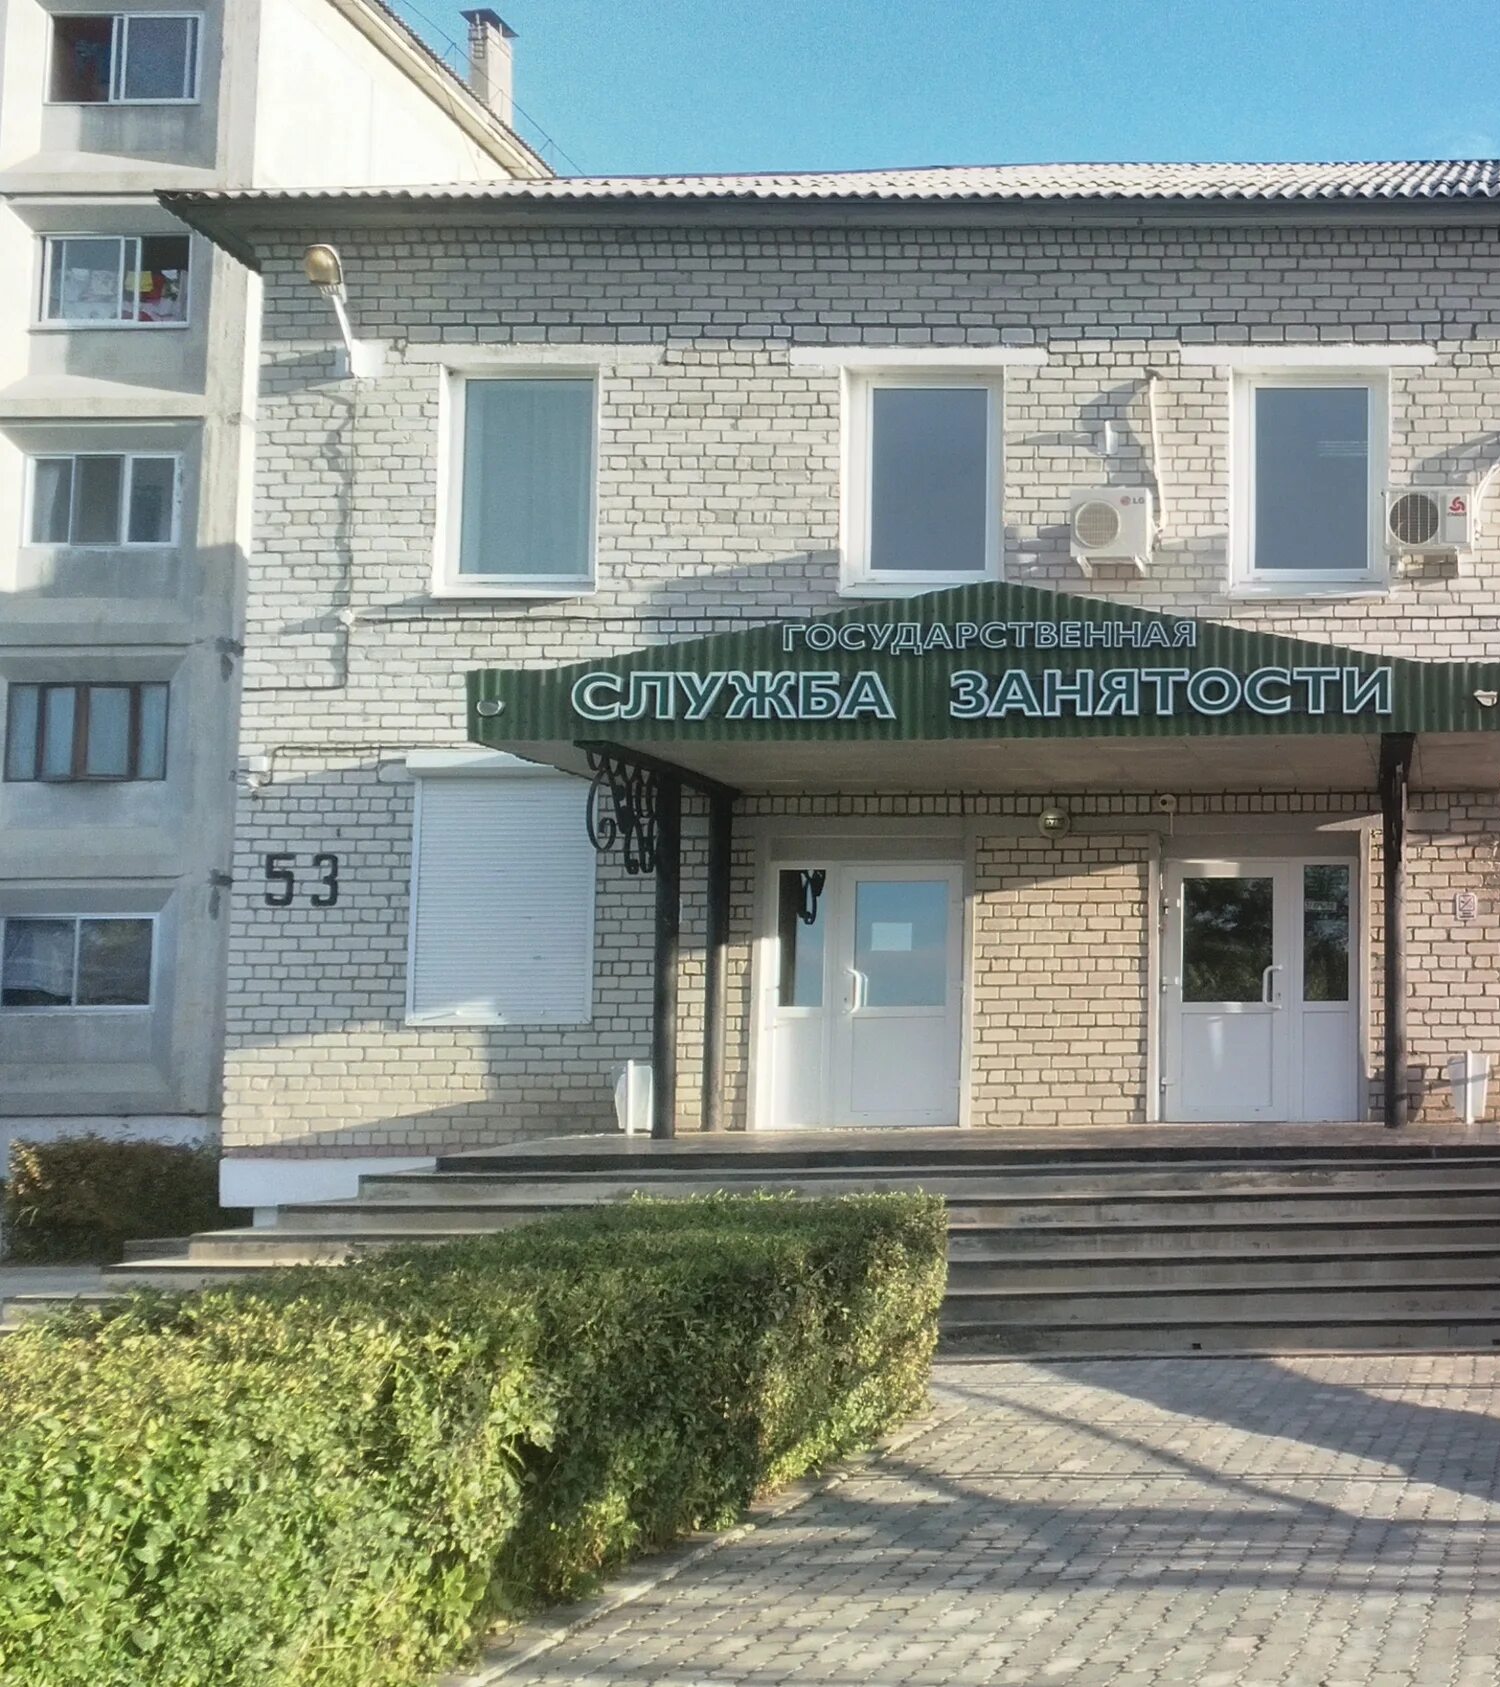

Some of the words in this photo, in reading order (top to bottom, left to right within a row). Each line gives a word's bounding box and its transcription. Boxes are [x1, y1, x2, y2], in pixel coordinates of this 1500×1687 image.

[1132, 496, 1145, 504] LG
[782, 621, 1197, 655] ГОСУДАРСТВЕННАЯ
[571, 671, 896, 720] СЛУЖБА
[950, 667, 1392, 717] ЗАНЯТОСТИ
[265, 854, 338, 906] 53
